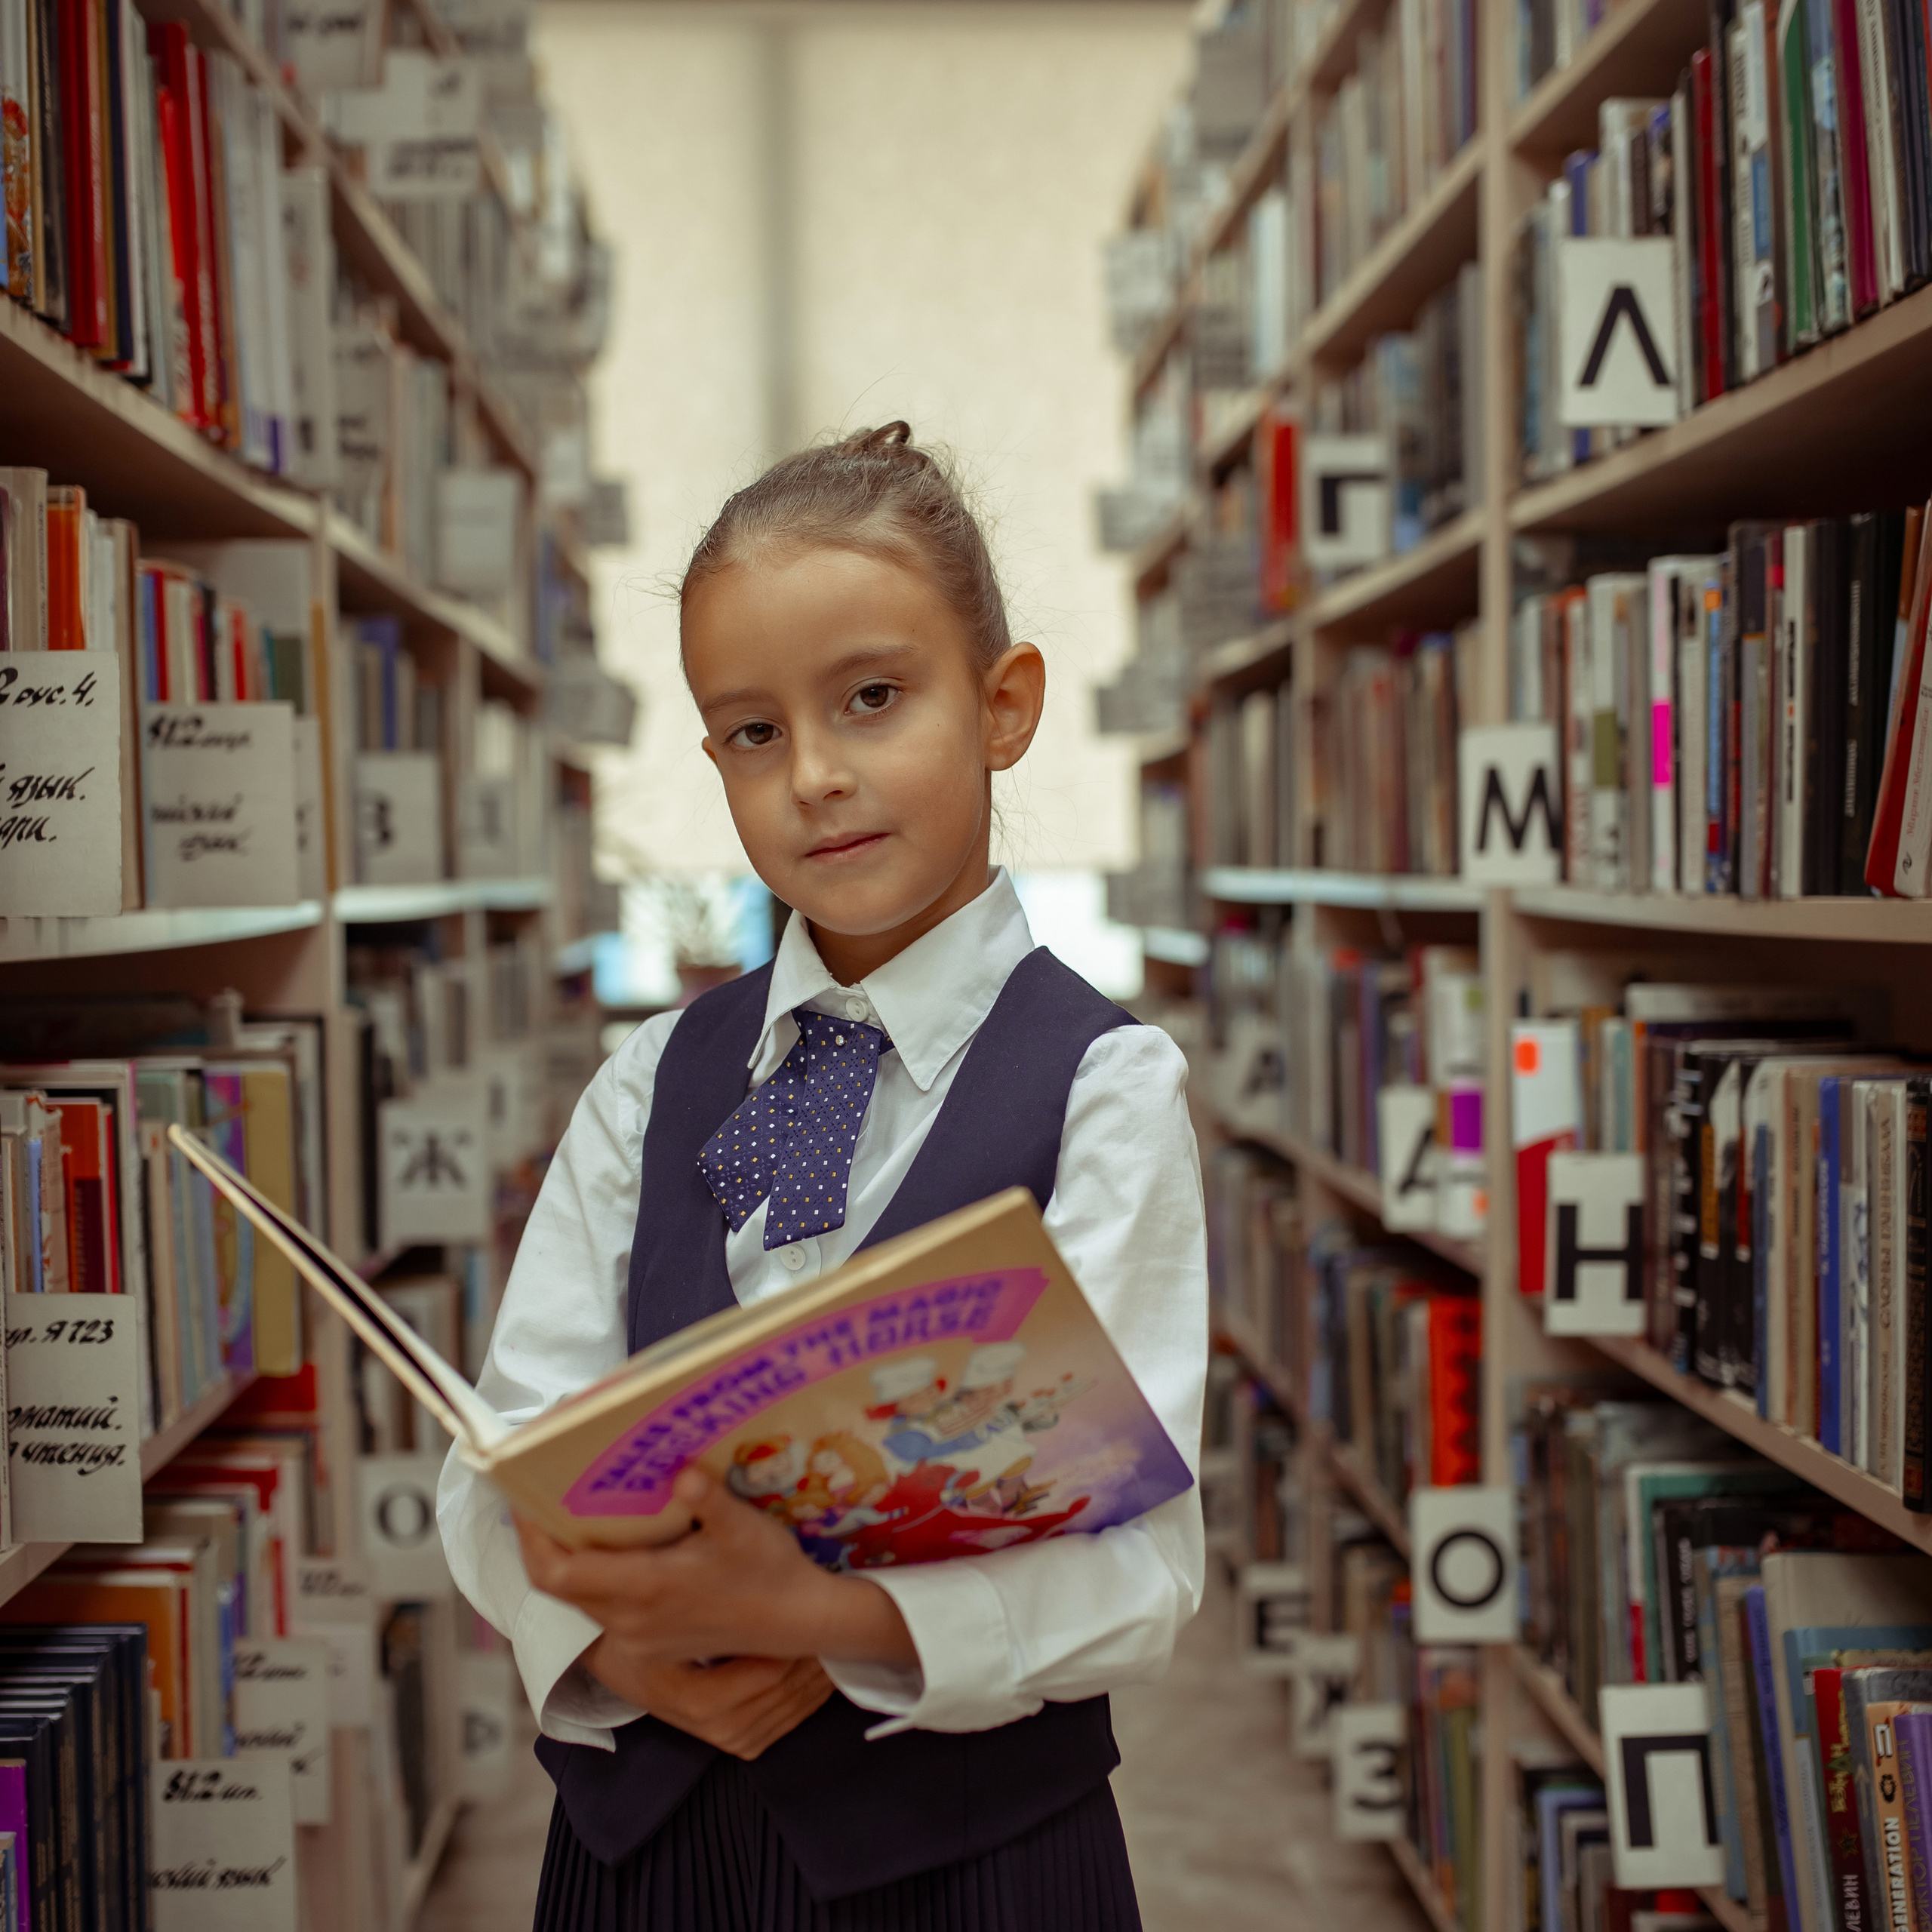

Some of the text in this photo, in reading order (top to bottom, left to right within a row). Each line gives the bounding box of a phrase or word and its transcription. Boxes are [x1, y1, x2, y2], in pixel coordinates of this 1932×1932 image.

[1476, 766, 1564, 853] М
[1555, 1202, 1644, 1300] Н
[1430, 1530, 1505, 1608] О
[1621, 1734, 1720, 1848] П
[1897, 1739, 1920, 1841] ПЕЛЕВИН
